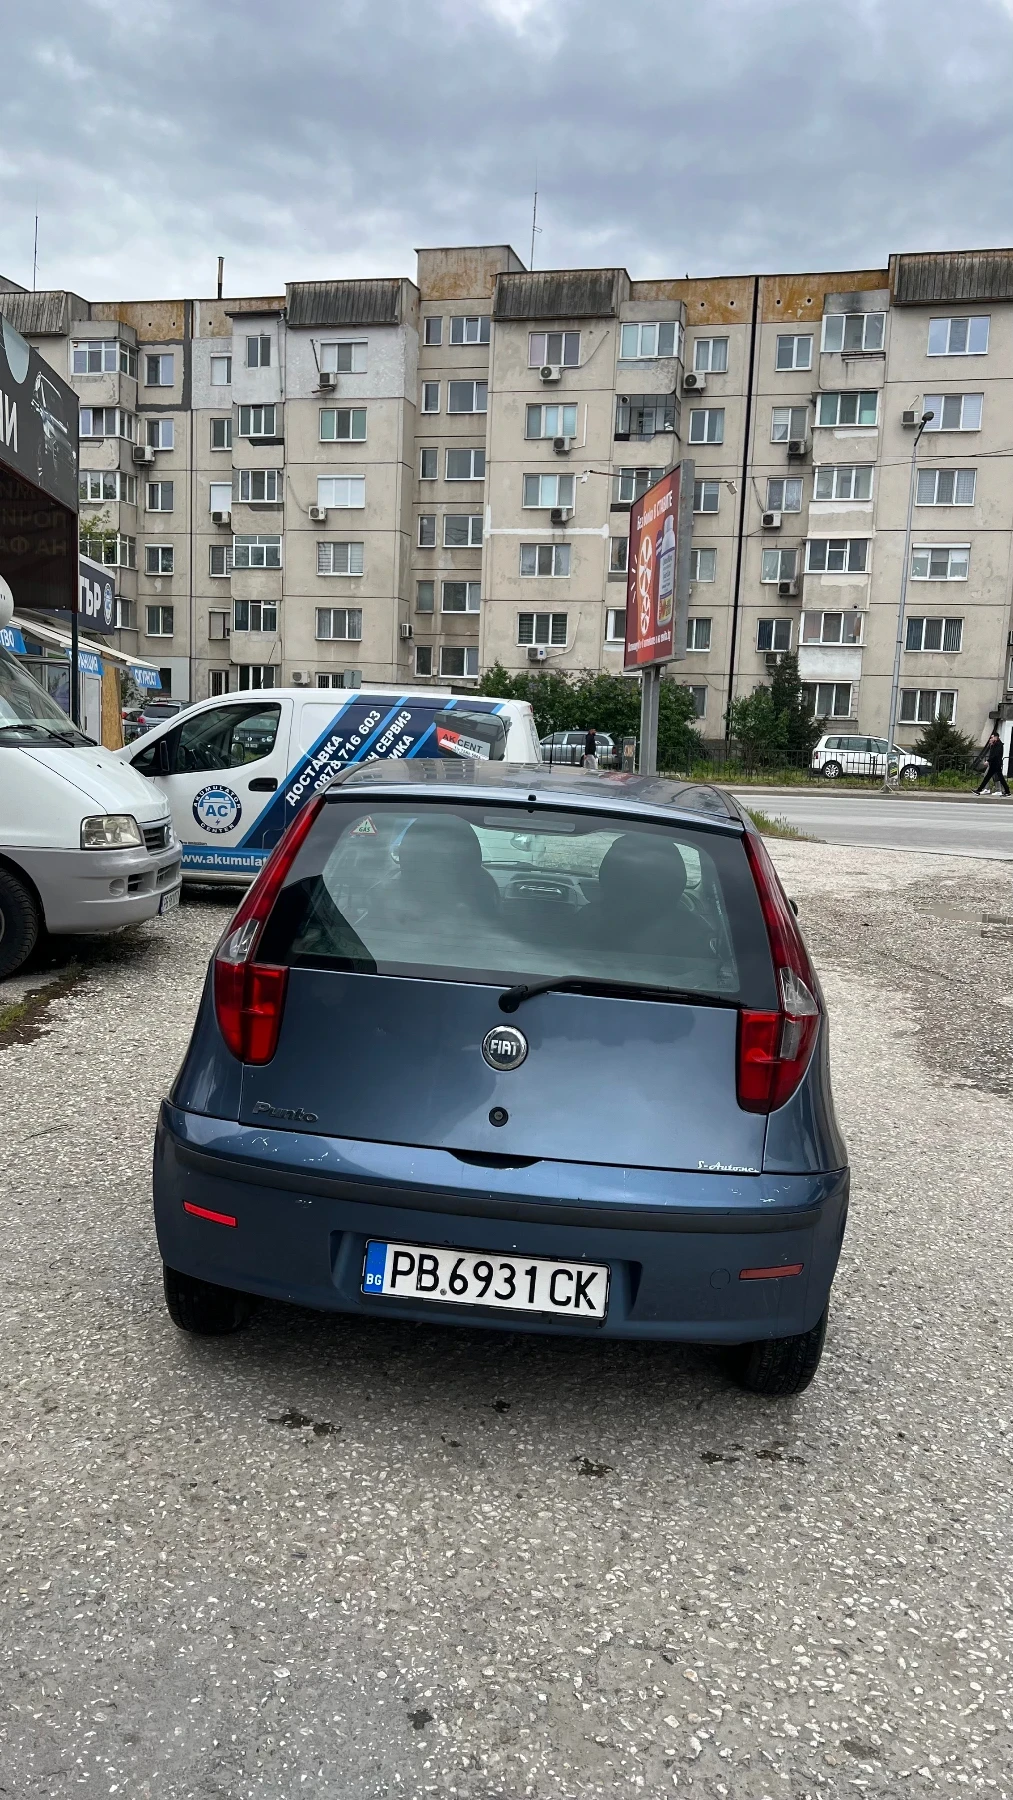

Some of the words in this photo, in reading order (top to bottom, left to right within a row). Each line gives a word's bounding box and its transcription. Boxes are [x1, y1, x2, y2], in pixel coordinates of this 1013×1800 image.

[0, 629, 15, 648] ТВО
[338, 735, 361, 760] 716
[358, 710, 381, 735] 603
[375, 711, 412, 753] СЕРВИЗ
[386, 735, 415, 760] ИКА
[285, 735, 344, 807] ДОСТАВКА
[205, 804, 229, 817] AC
[490, 1039, 520, 1056] FIAT
[252, 1100, 319, 1123] Punto
[366, 1274, 383, 1286] BG
